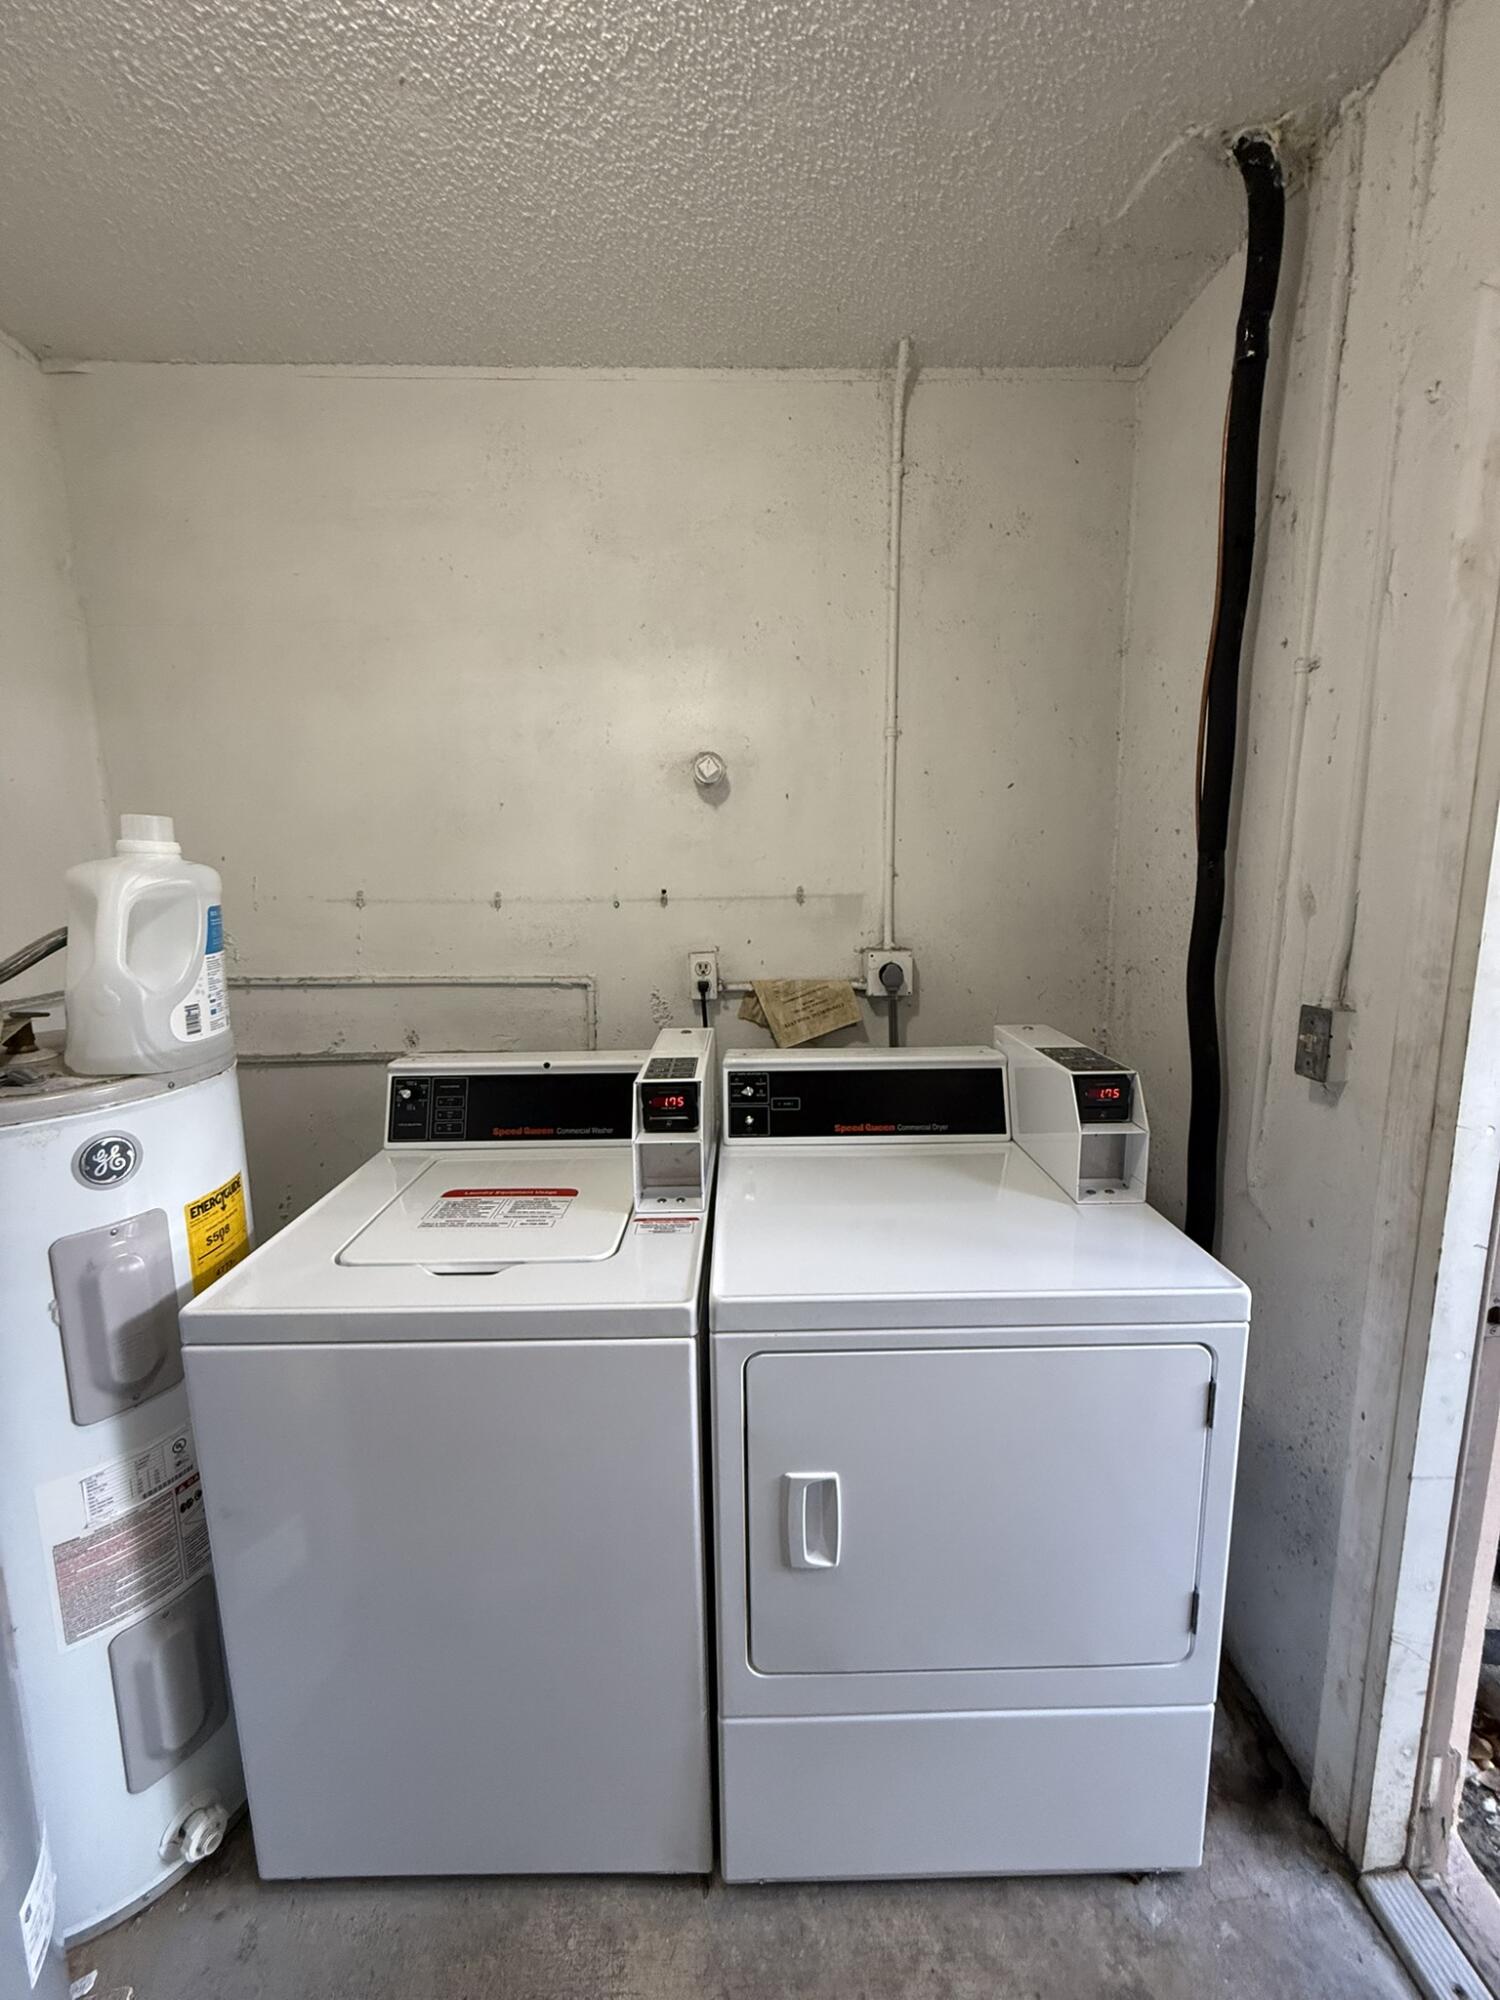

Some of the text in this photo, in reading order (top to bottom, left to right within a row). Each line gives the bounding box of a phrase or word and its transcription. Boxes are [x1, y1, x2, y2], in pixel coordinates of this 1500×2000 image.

[492, 1127, 522, 1136] Speed
[523, 1126, 554, 1135] Queen
[834, 1123, 864, 1133] Speed
[865, 1123, 895, 1132] Queen
